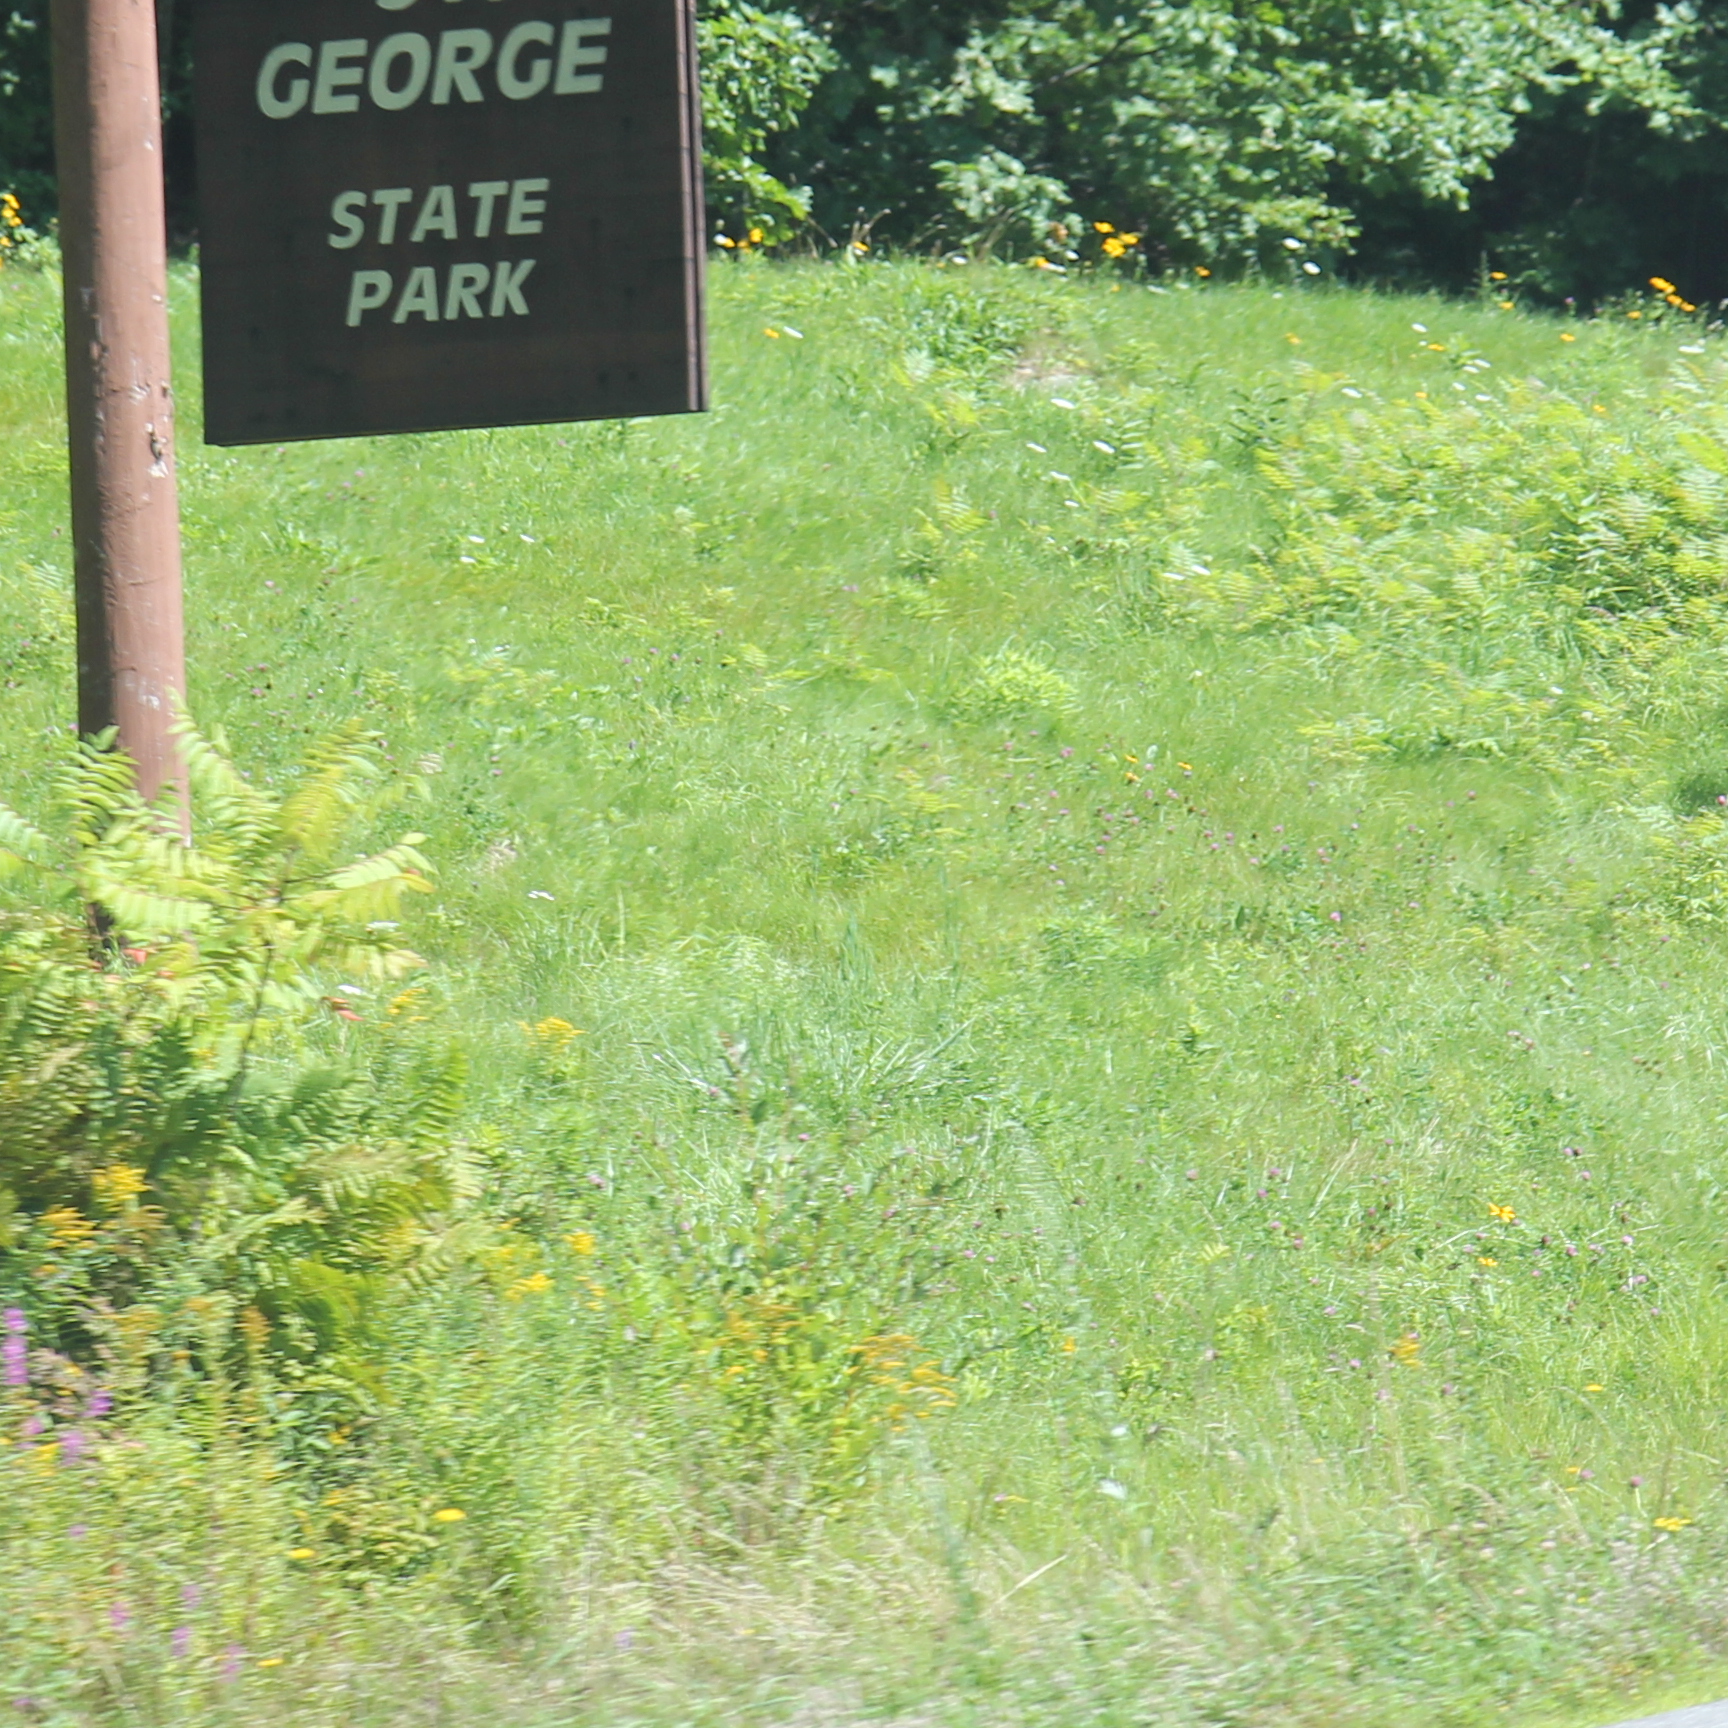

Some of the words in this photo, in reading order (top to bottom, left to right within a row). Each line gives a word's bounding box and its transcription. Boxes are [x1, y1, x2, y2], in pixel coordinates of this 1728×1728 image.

[257, 18, 611, 119] GEORGE
[328, 178, 549, 249] STATE
[346, 259, 536, 327] PARK
